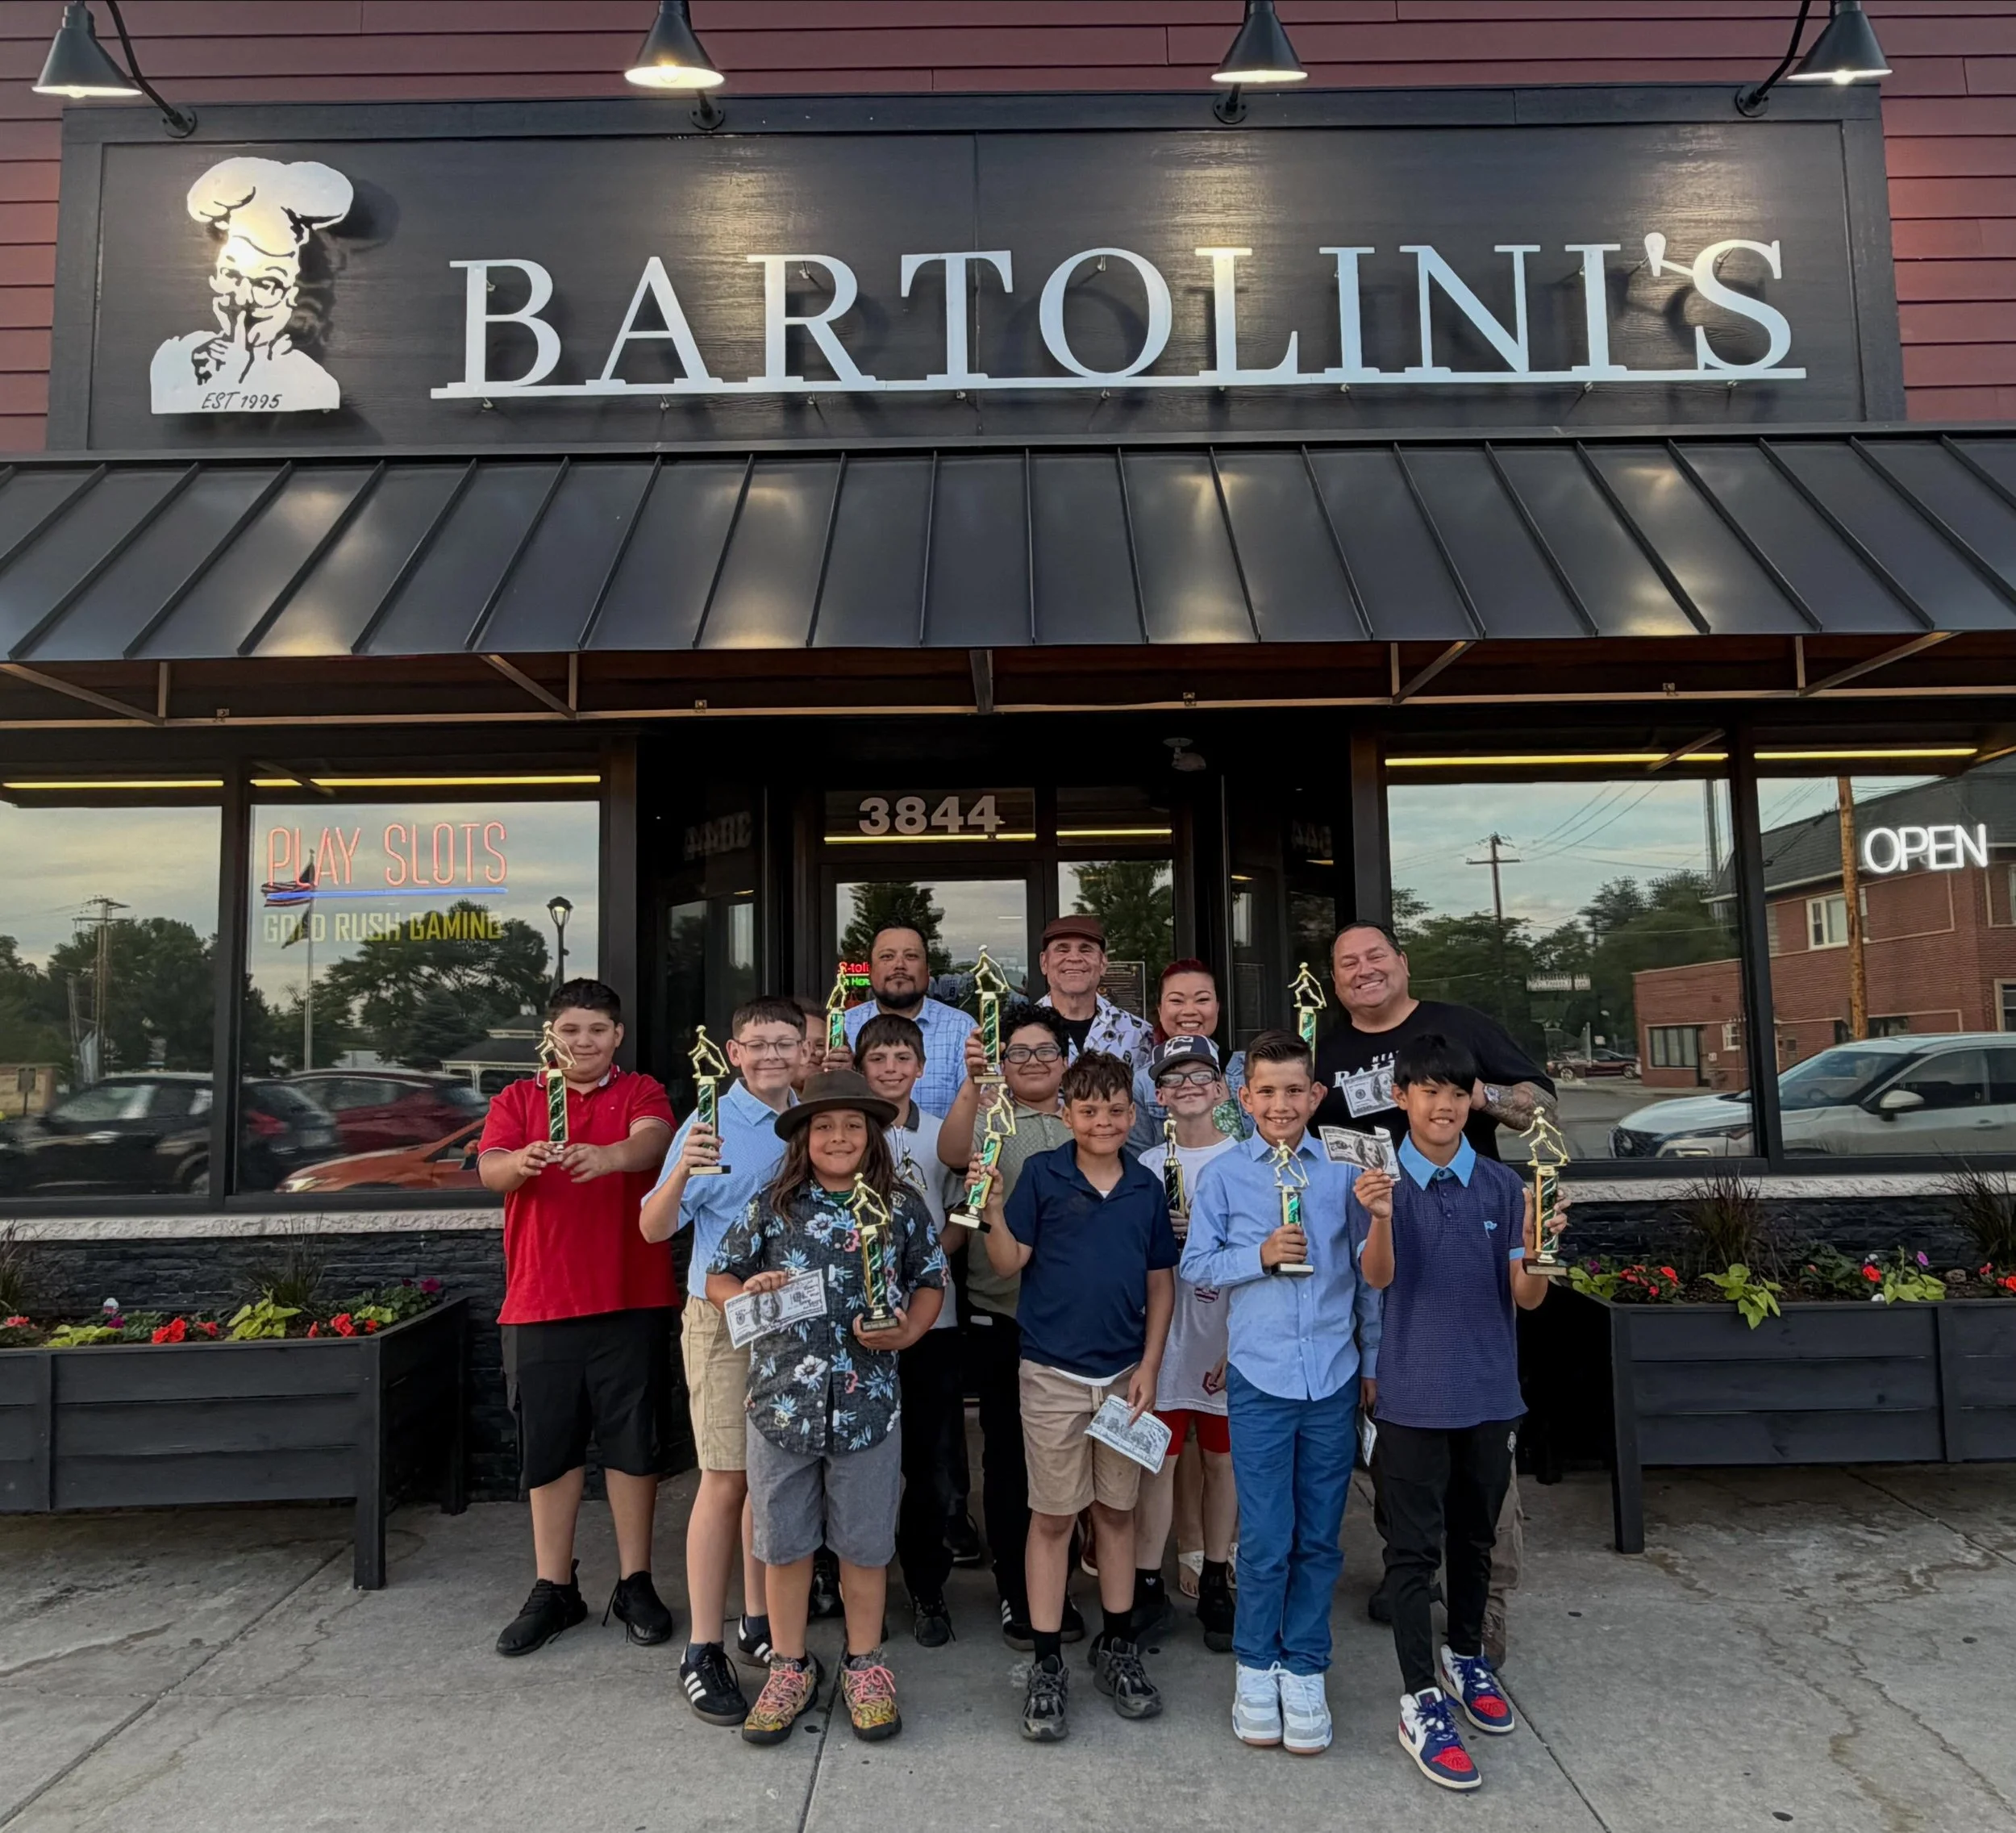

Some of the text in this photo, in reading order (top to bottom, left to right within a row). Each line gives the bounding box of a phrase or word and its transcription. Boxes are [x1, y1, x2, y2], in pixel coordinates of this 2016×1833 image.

[445, 232, 1794, 389] BARTOLINI'S
[202, 392, 282, 410] EST 1995
[859, 795, 1001, 835] 3844
[267, 821, 507, 887] PLAY SLOTS
[1864, 823, 1988, 873] OPEN
[335, 912, 401, 943] RUSH
[410, 910, 503, 941] GAMING
